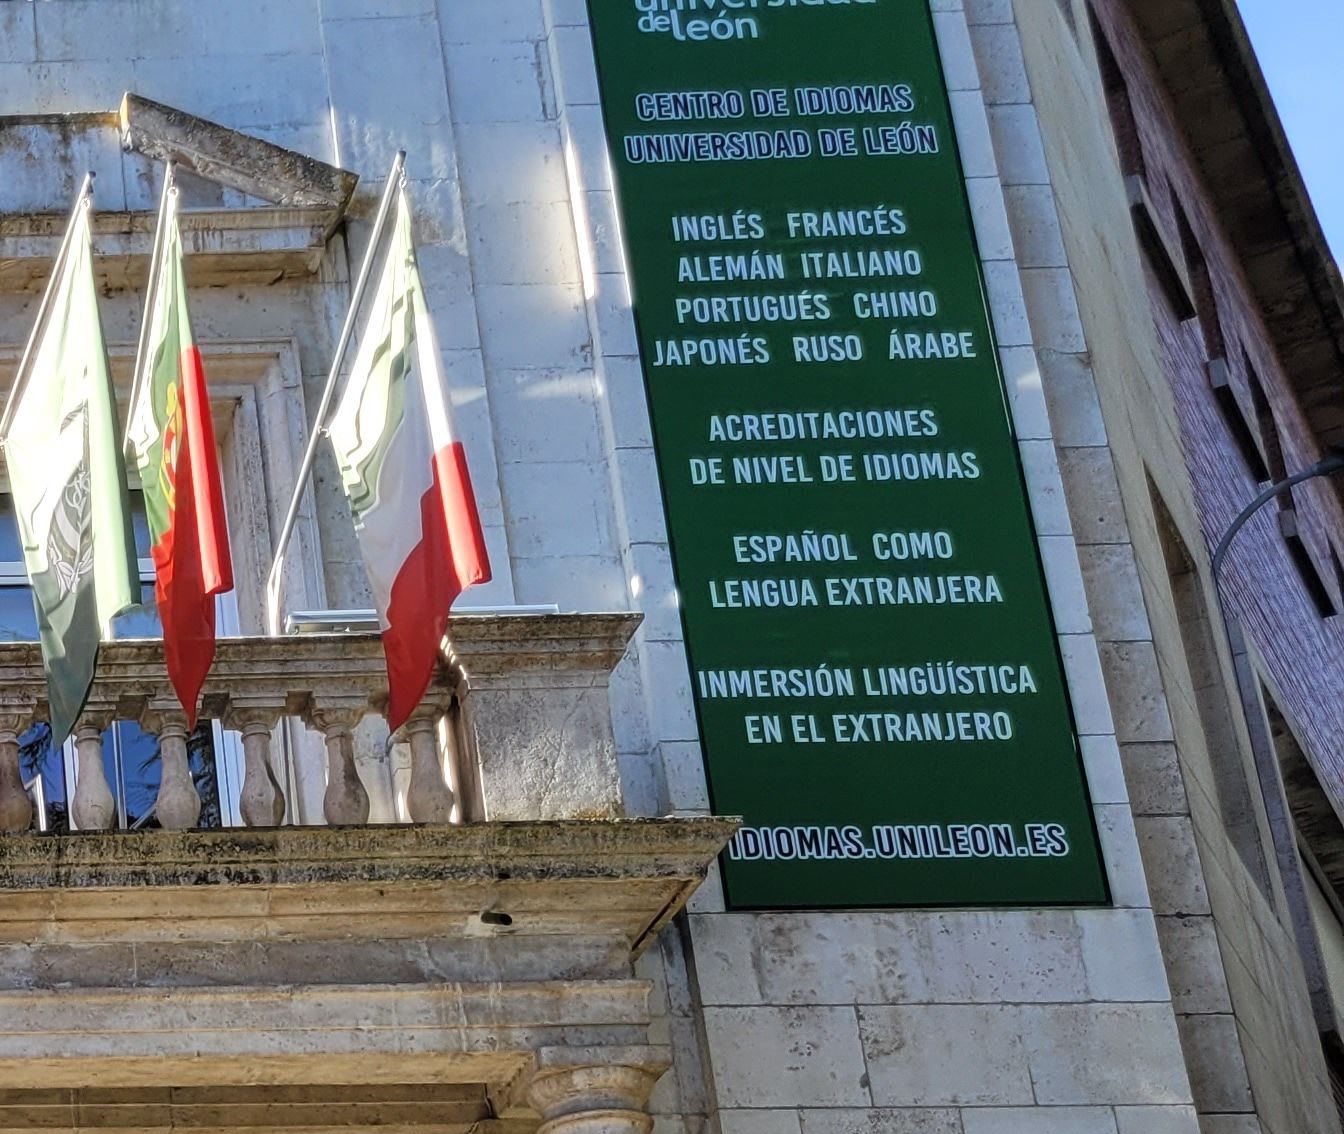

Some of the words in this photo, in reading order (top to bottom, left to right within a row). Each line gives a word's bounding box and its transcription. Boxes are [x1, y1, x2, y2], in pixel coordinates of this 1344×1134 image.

[635, 90, 744, 121] CENTRO
[750, 88, 790, 118] DE
[794, 84, 915, 116] IDIOMAS
[624, 130, 812, 163] UNIVERSIDAD
[818, 127, 859, 157] DE
[863, 121, 939, 156] LEÓN
[671, 209, 765, 242] INGLÉS
[786, 204, 907, 239] FRANCÉS
[677, 248, 785, 283] ALEMÁN
[801, 249, 923, 280] ITALIANO
[676, 288, 831, 324] PORTUGUÉS
[853, 290, 938, 319] CHINO
[653, 332, 770, 367] JAPONÉS
[793, 334, 863, 362] RUSO
[888, 328, 977, 360] ÁRABE
[708, 409, 939, 441] ACREDITACIONES
[689, 456, 726, 485] DE
[733, 454, 814, 484] NIVEL
[820, 454, 856, 483] DE
[863, 451, 981, 481] IDIOMAS
[733, 530, 858, 563] ESPAÑOL
[872, 531, 954, 561] COMO
[709, 578, 817, 608] LENGUA
[825, 574, 1004, 606] EXTRANJERA
[698, 662, 854, 698] INMERSIÓN
[863, 661, 1037, 696] LINGÜÍSTICA
[745, 714, 783, 744] EN
[792, 714, 826, 743] EL
[833, 711, 1013, 742] EXTRANJERO
[728, 823, 1070, 861] IDIOMAS.UNILEON.ES
